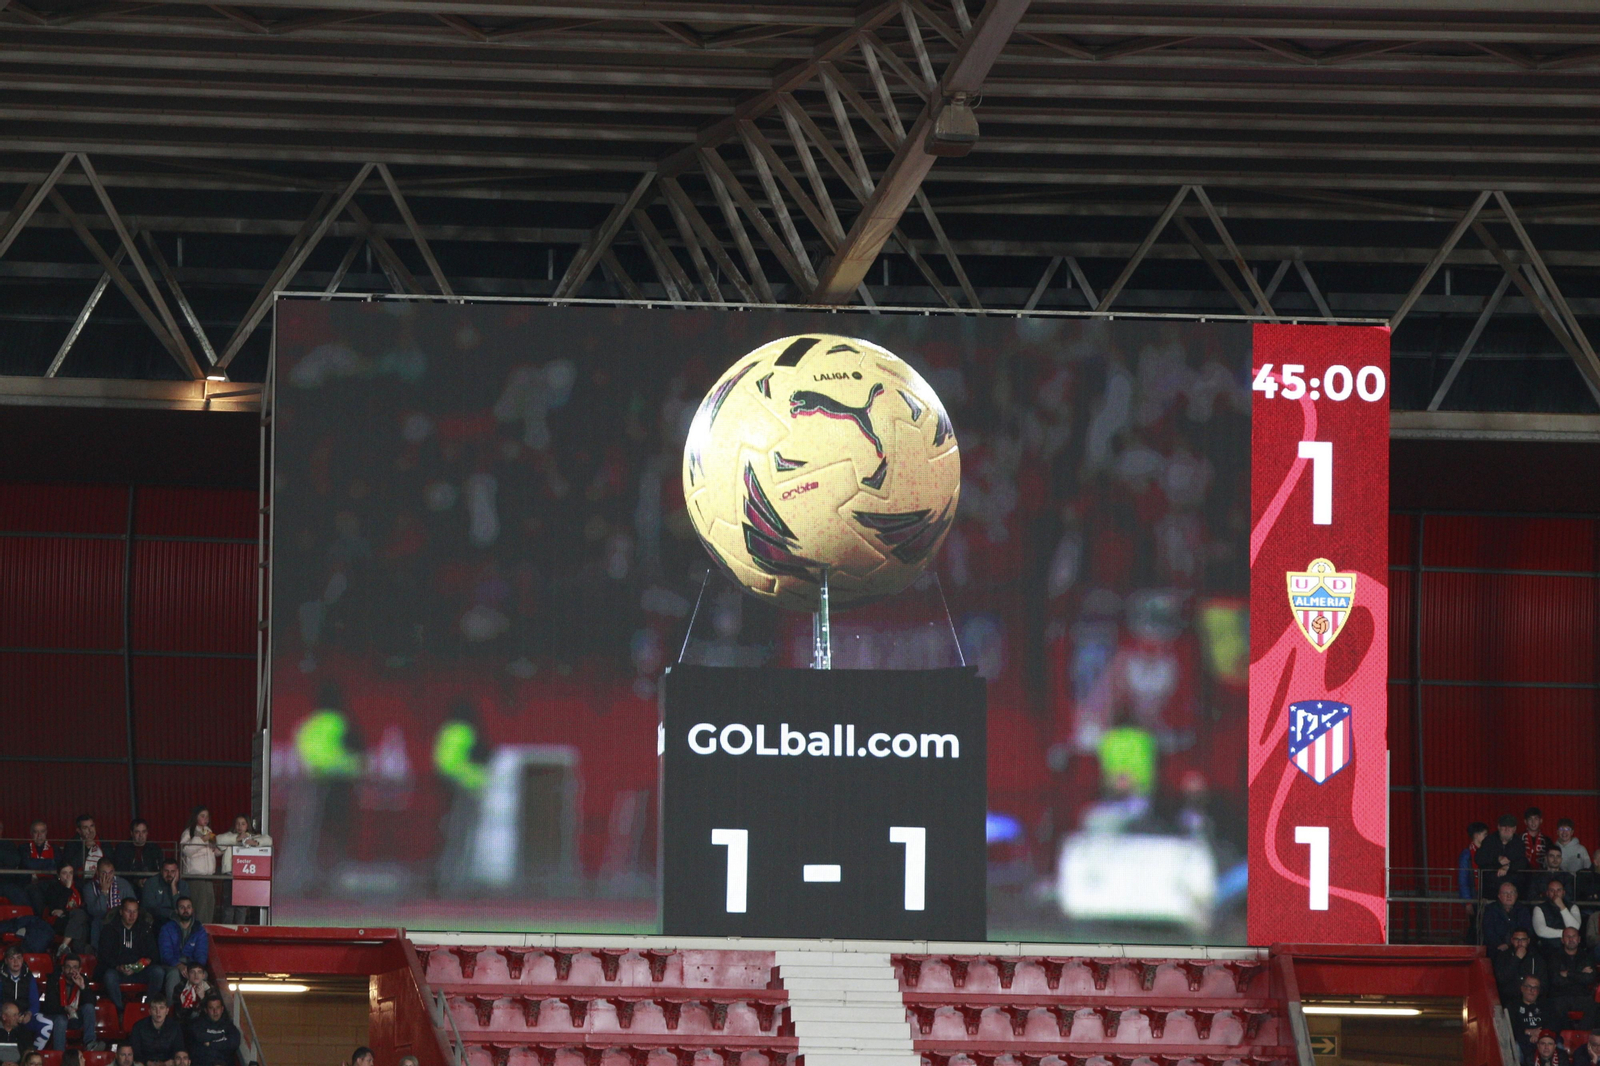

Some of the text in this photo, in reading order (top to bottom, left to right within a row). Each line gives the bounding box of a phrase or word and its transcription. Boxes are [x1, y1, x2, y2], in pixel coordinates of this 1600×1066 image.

[813, 372, 850, 382] LALIGA
[1252, 363, 1386, 402] 45:00
[1298, 441, 1333, 525] 1
[1295, 578, 1347, 591] U D
[1295, 596, 1348, 607] ALMERIA
[687, 722, 960, 759] GOLball.com
[242, 864, 256, 874] 48
[711, 828, 749, 914] 1
[889, 826, 927, 911] 1
[1294, 826, 1330, 911] 1
